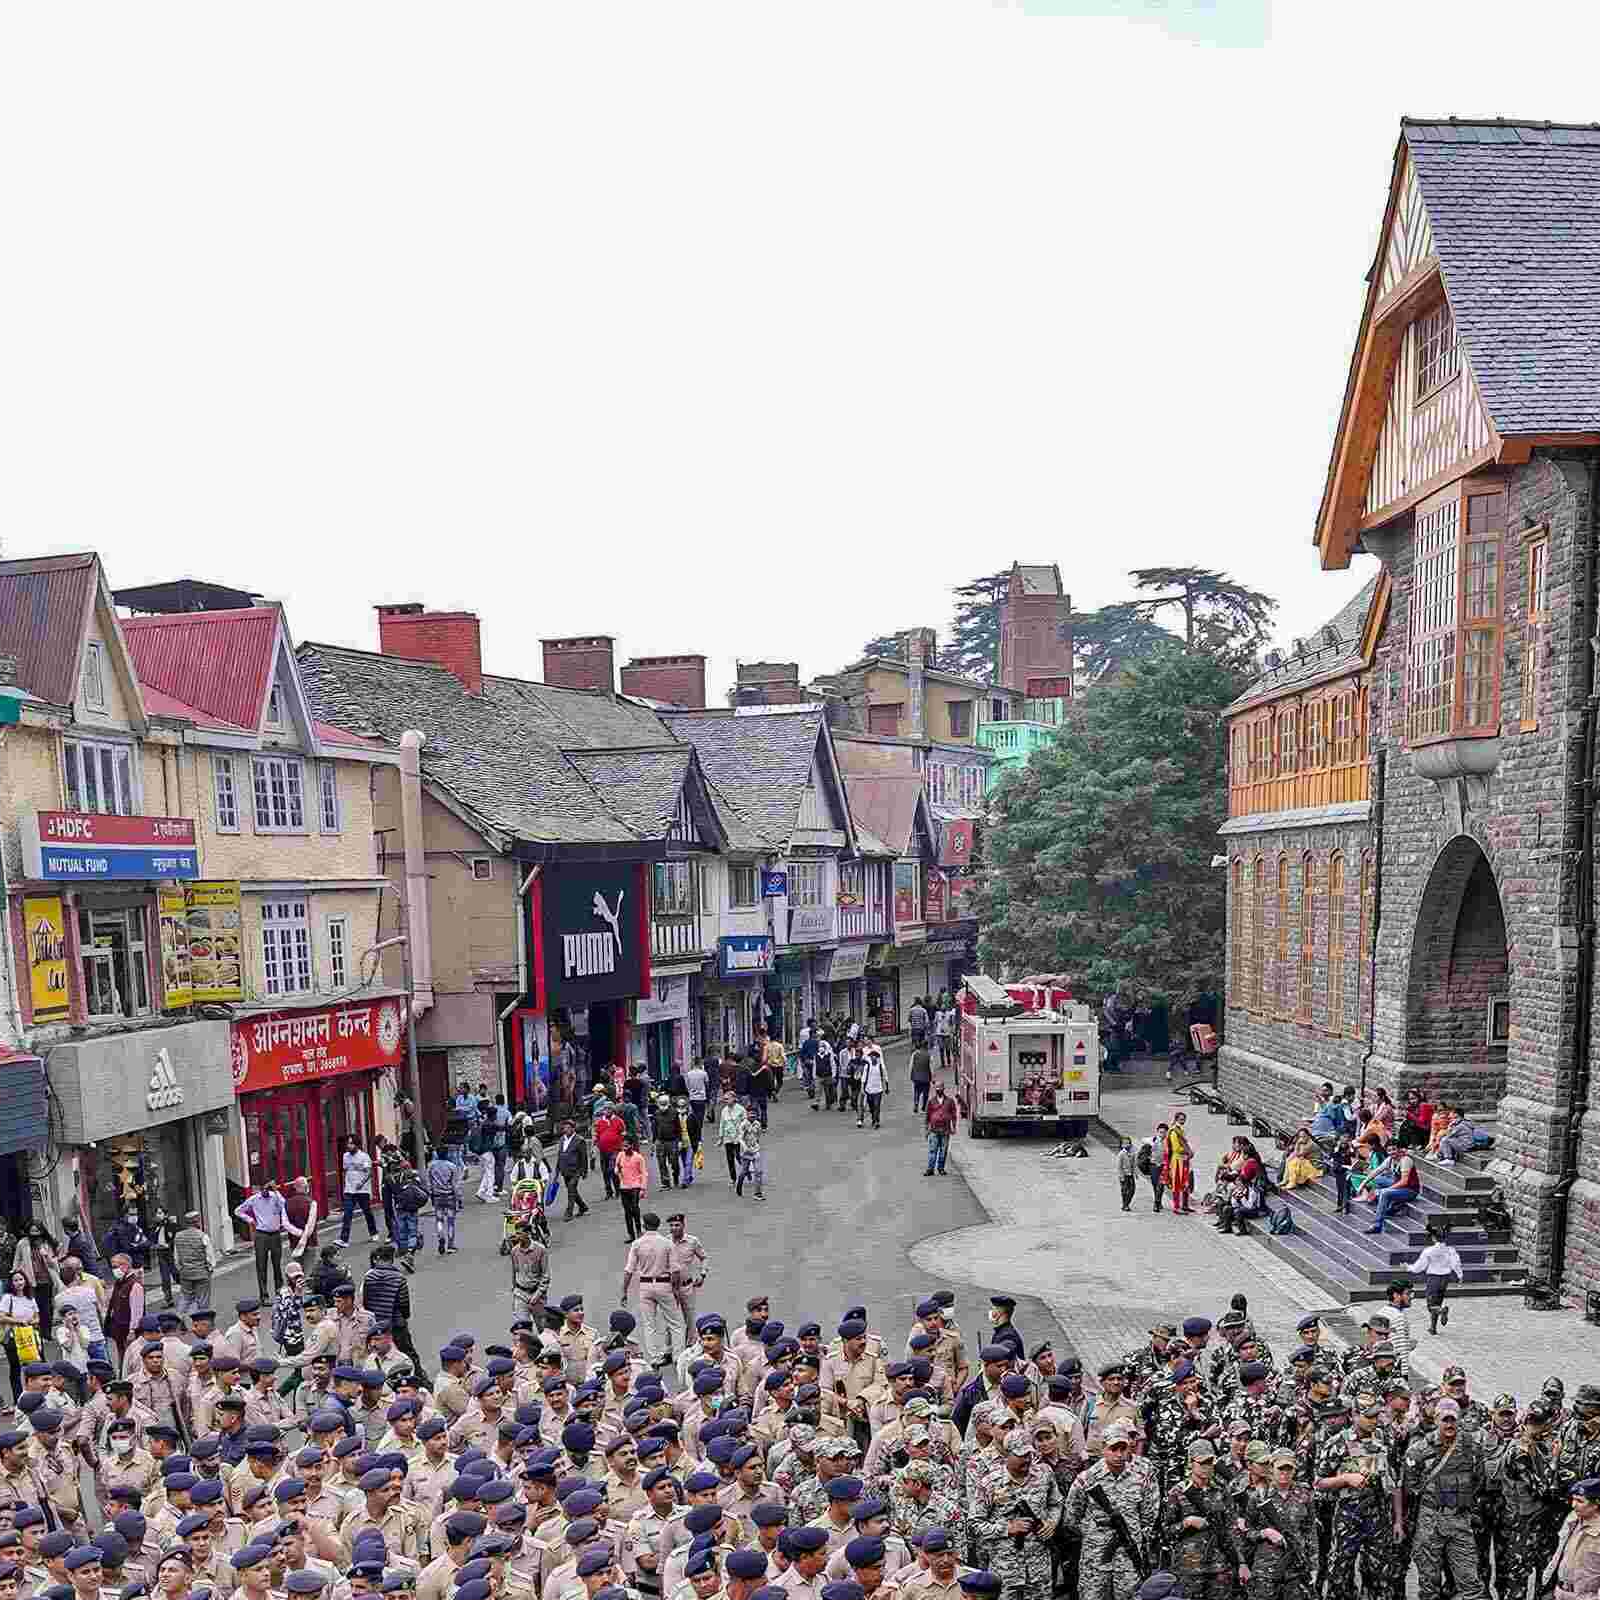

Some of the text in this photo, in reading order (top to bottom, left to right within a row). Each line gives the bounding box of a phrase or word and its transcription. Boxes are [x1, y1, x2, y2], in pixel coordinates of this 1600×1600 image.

[56, 816, 93, 838] HDFC
[48, 857, 109, 874] MUTUAL FUND
[560, 932, 614, 978] PUMA
[253, 1012, 332, 1054] अग्निशमन
